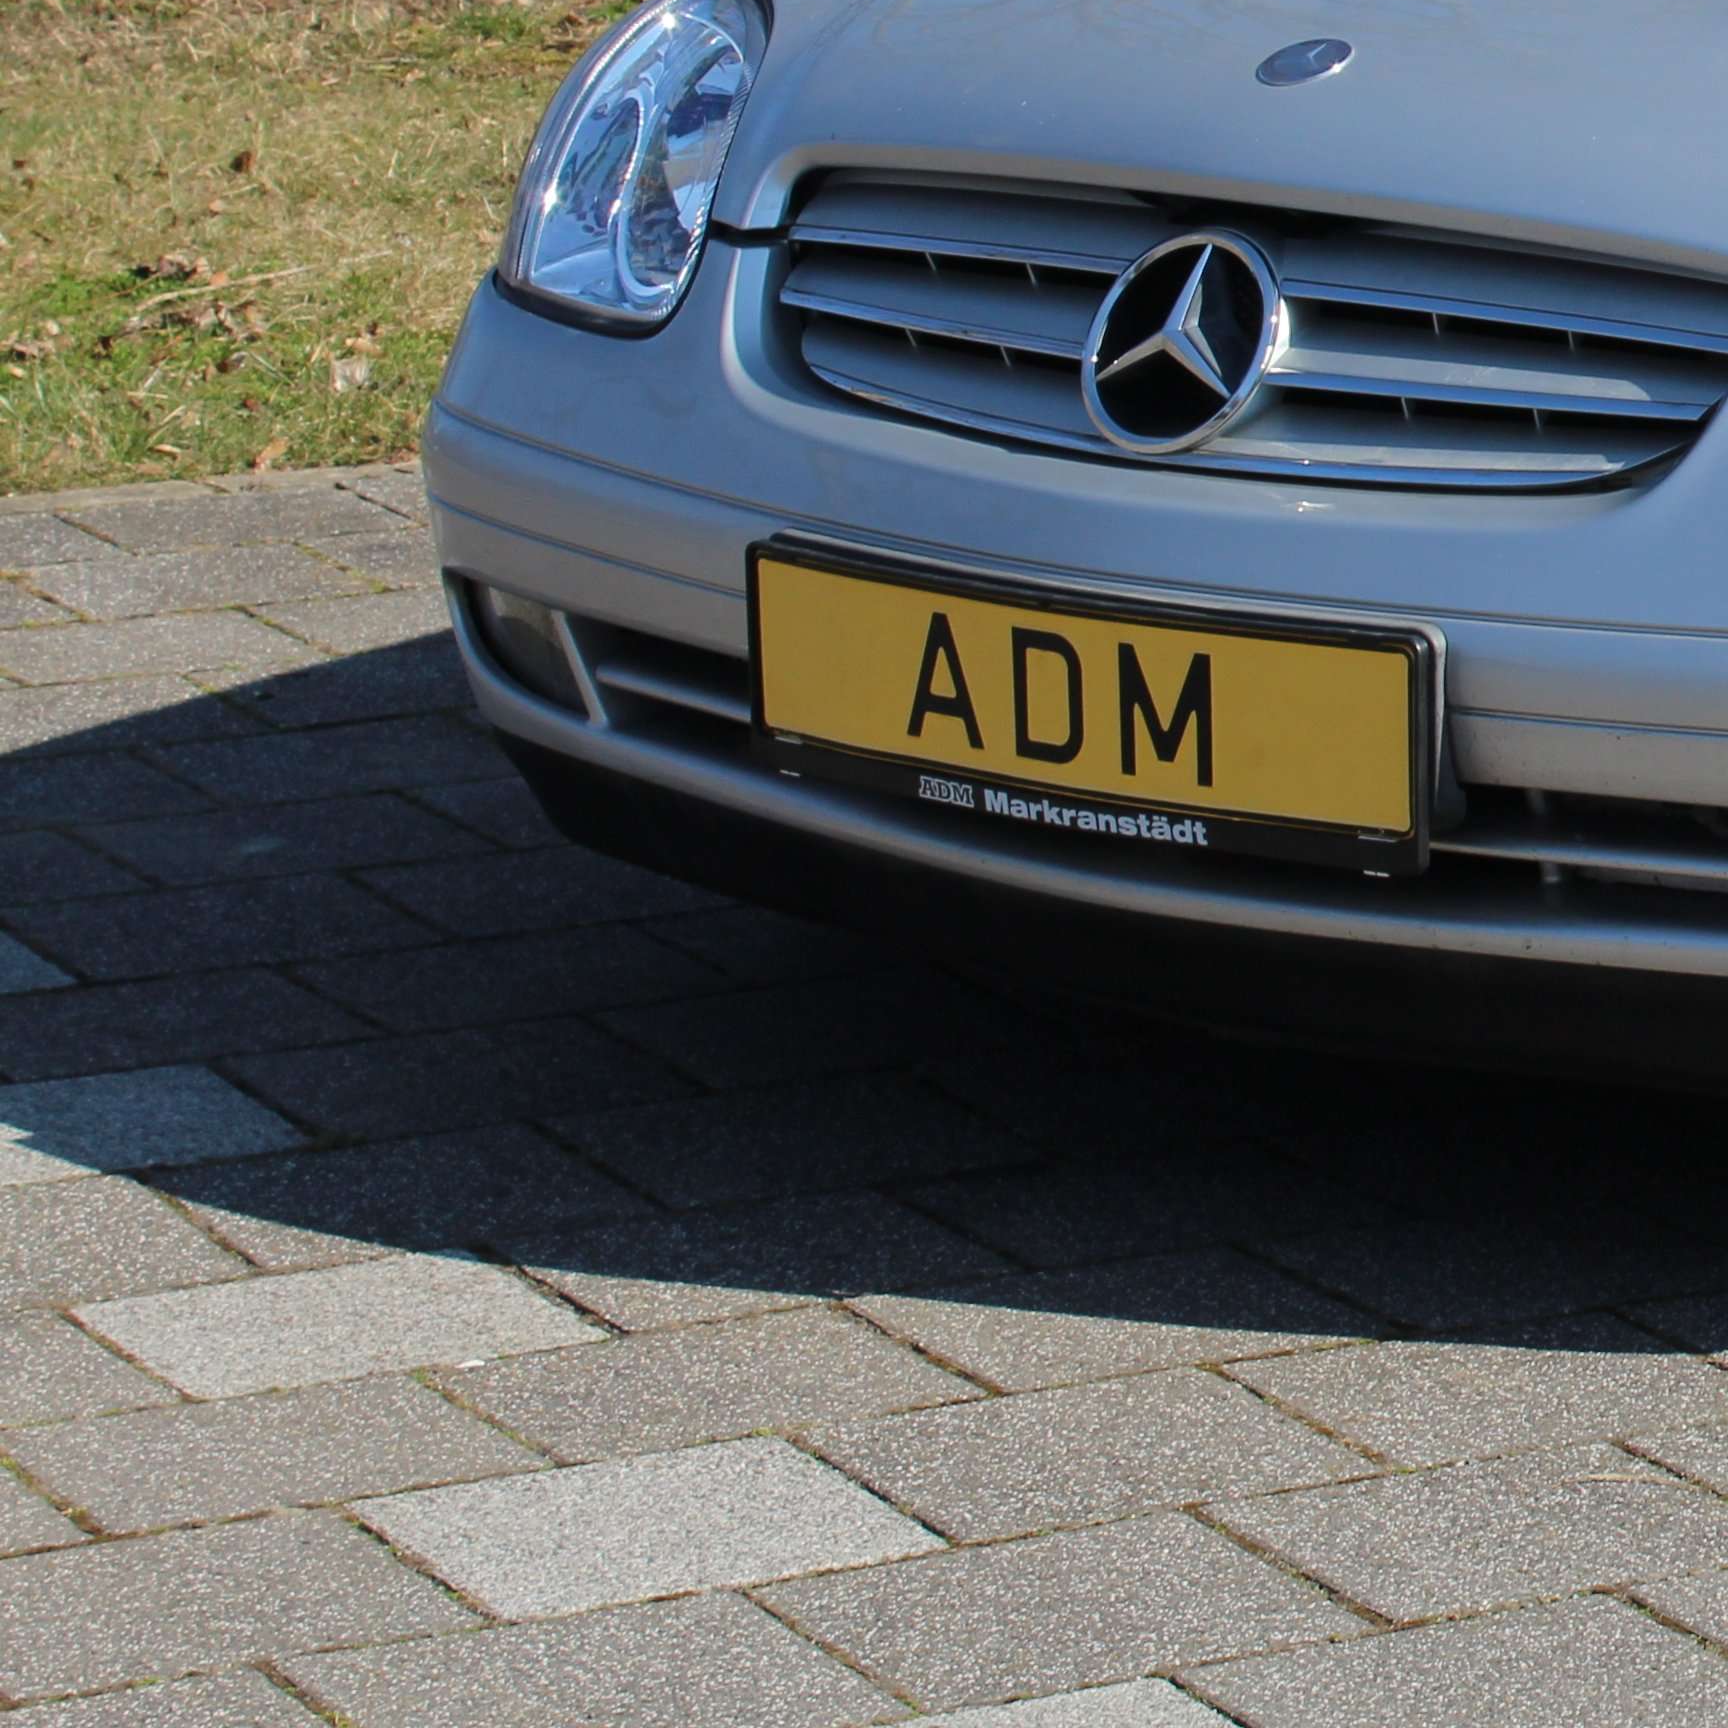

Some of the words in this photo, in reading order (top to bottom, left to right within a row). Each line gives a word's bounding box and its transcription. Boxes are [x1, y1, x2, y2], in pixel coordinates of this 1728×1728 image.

[907, 611, 1213, 788] ADM
[919, 775, 975, 808] ADM
[984, 788, 1209, 846] Markranstädt
